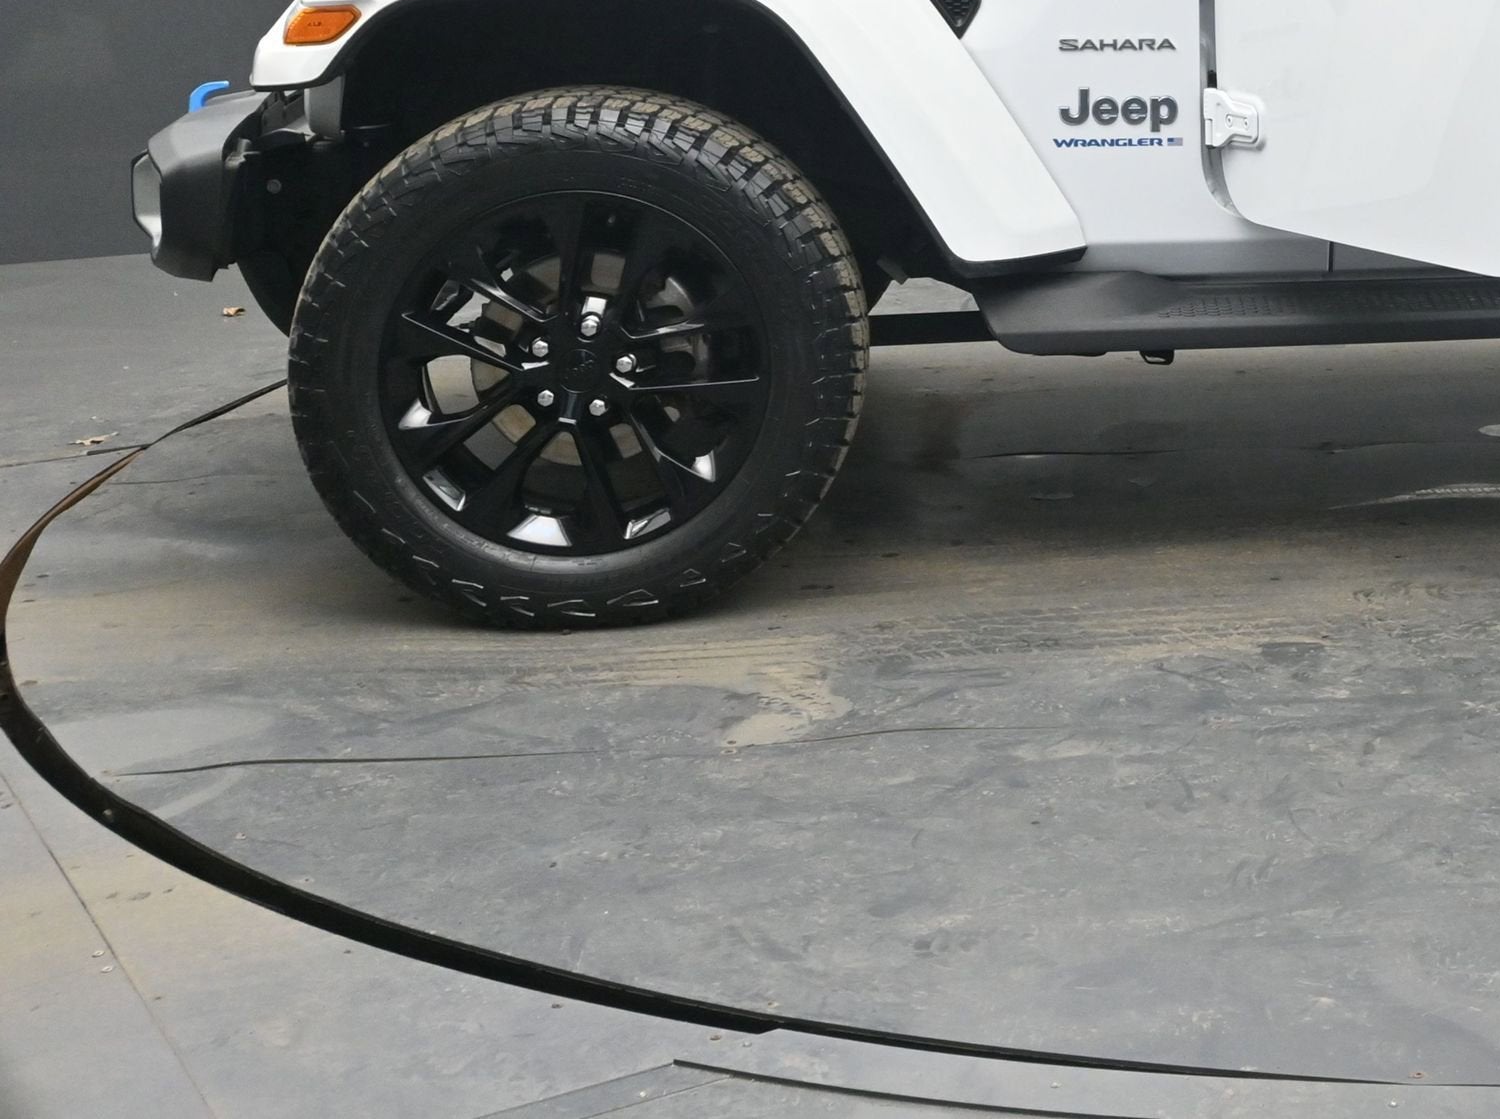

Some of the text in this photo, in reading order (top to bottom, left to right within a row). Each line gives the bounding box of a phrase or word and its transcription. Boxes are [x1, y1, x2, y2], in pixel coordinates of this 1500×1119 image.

[1058, 38, 1176, 51] SAHARA
[1059, 86, 1178, 132] Jeep
[1053, 137, 1163, 148] WRANGLER
